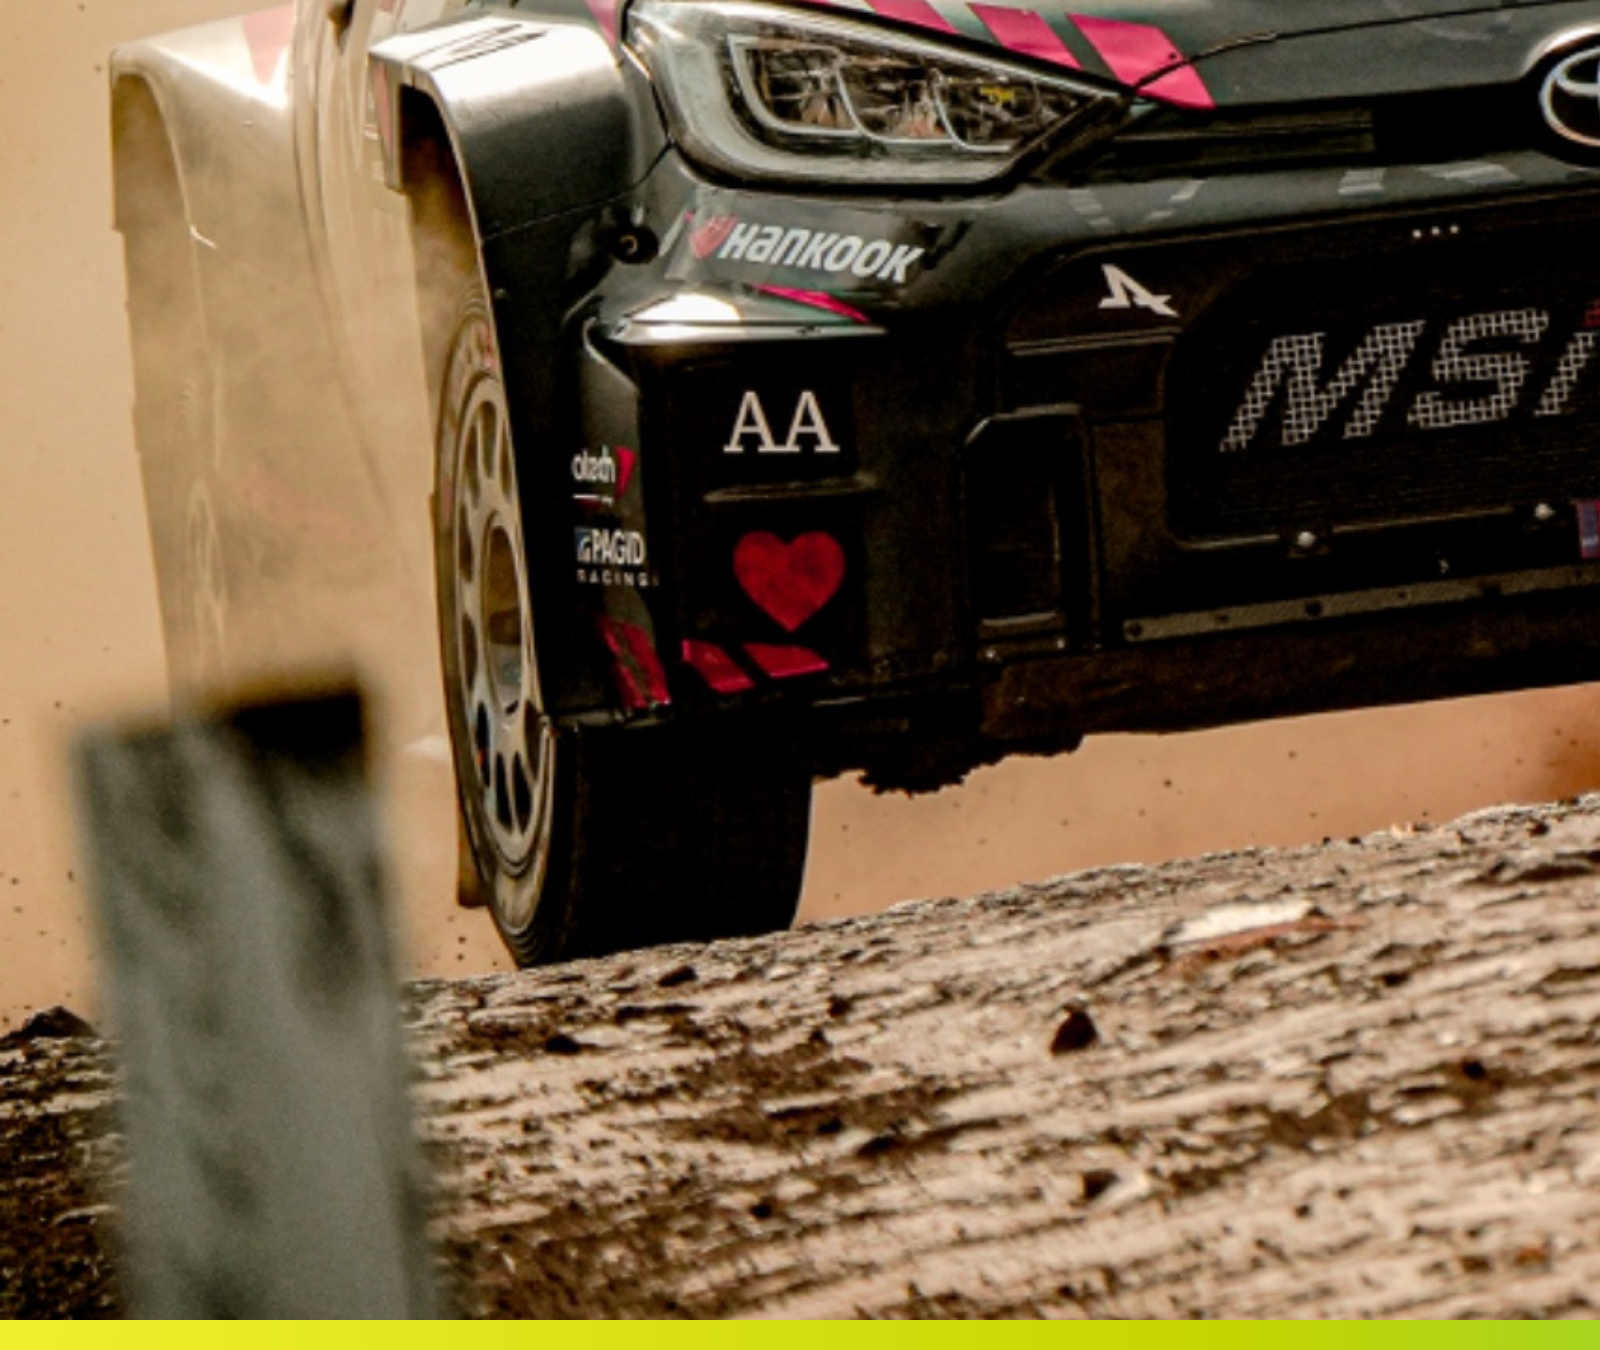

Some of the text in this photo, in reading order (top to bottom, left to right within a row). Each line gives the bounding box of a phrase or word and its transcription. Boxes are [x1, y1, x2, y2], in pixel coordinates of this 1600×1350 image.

[723, 390, 840, 453] AA
[591, 527, 646, 565] PAGID
[576, 568, 649, 588] RACING
